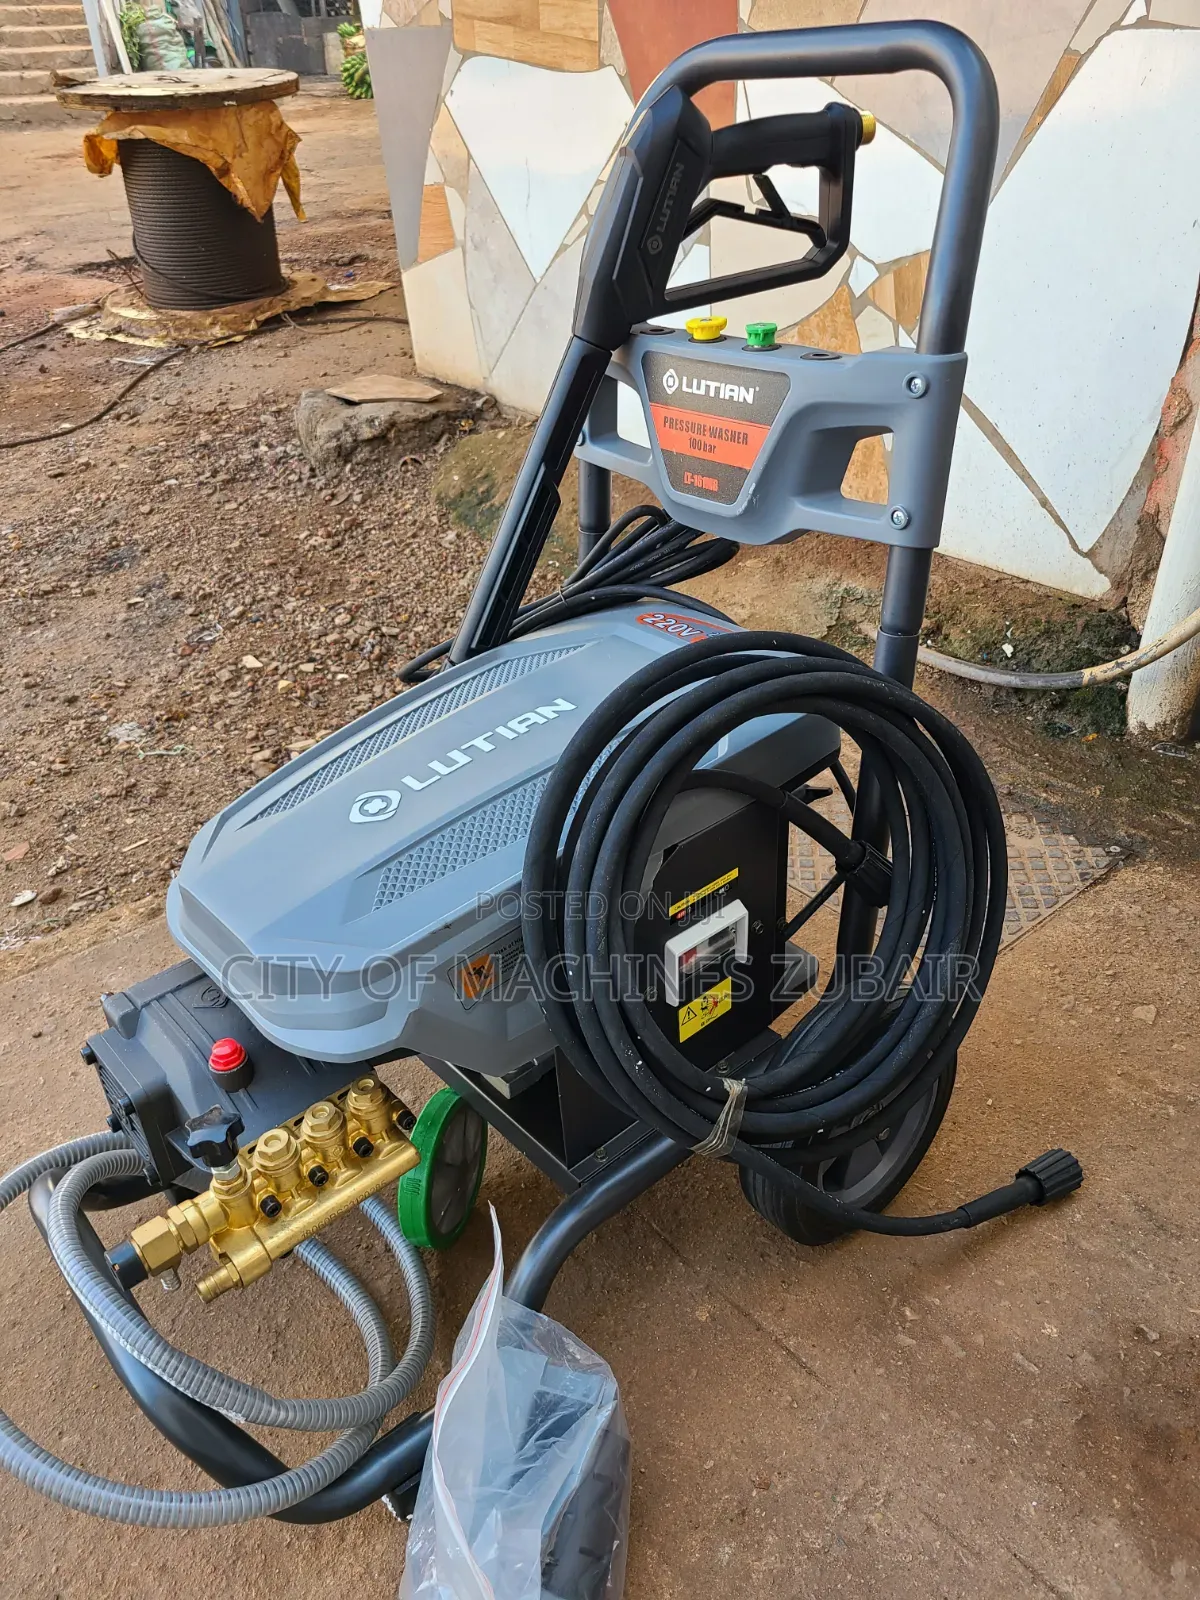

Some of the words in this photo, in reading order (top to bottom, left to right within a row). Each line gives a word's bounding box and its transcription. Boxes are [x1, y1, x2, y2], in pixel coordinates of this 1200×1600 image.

[656, 162, 685, 233] LUTIAN
[682, 376, 755, 405] LUTIAN
[663, 415, 707, 437] PRESSURE
[709, 425, 749, 446] WASHER
[688, 436, 702, 450] 100
[703, 440, 717, 455] bar
[643, 613, 700, 638] 220V
[400, 697, 578, 791] LUTIAN
